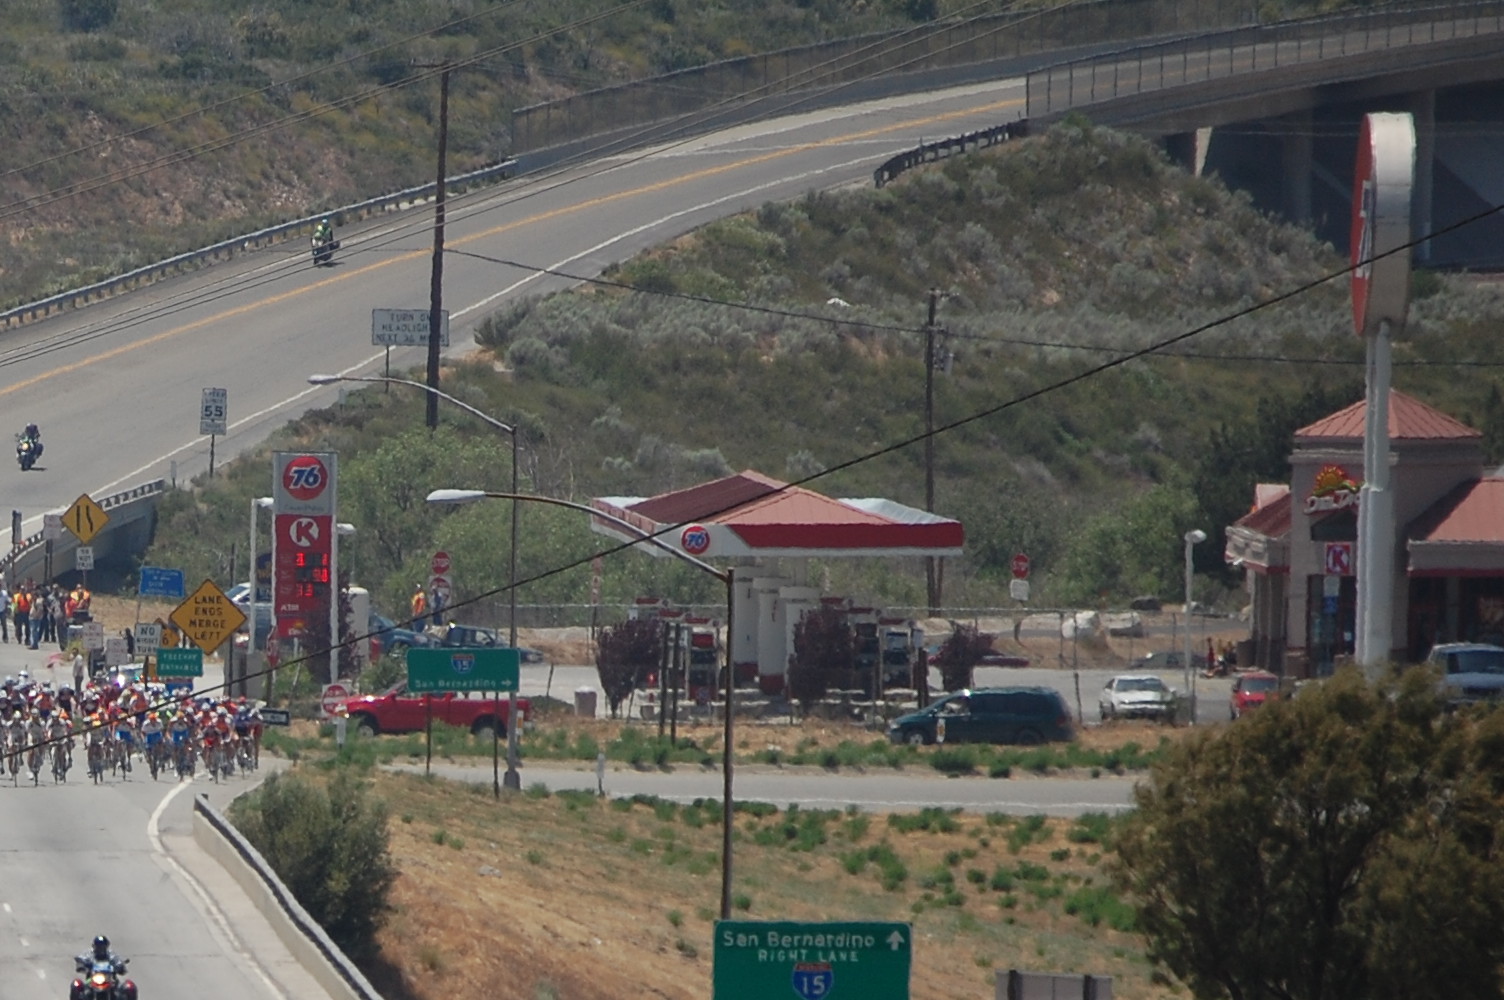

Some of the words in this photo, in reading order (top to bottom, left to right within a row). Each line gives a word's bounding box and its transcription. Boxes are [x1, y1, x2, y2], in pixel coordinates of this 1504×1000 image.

[382, 323, 431, 332] HEADLIGH
[204, 405, 223, 417] 55
[289, 464, 321, 489] 76
[296, 520, 318, 546] K
[686, 530, 707, 549] 76
[194, 596, 222, 604] LANE
[195, 607, 223, 616] ENDS
[189, 619, 226, 629] MERGE
[140, 626, 156, 636] NO
[194, 631, 221, 640] LEFT
[458, 661, 470, 671] 15
[415, 680, 435, 688] San
[722, 930, 759, 947] San
[767, 931, 876, 948] Bernardino
[757, 948, 808, 962] RIGHT
[818, 951, 859, 962] LANE
[802, 975, 826, 995] 15
